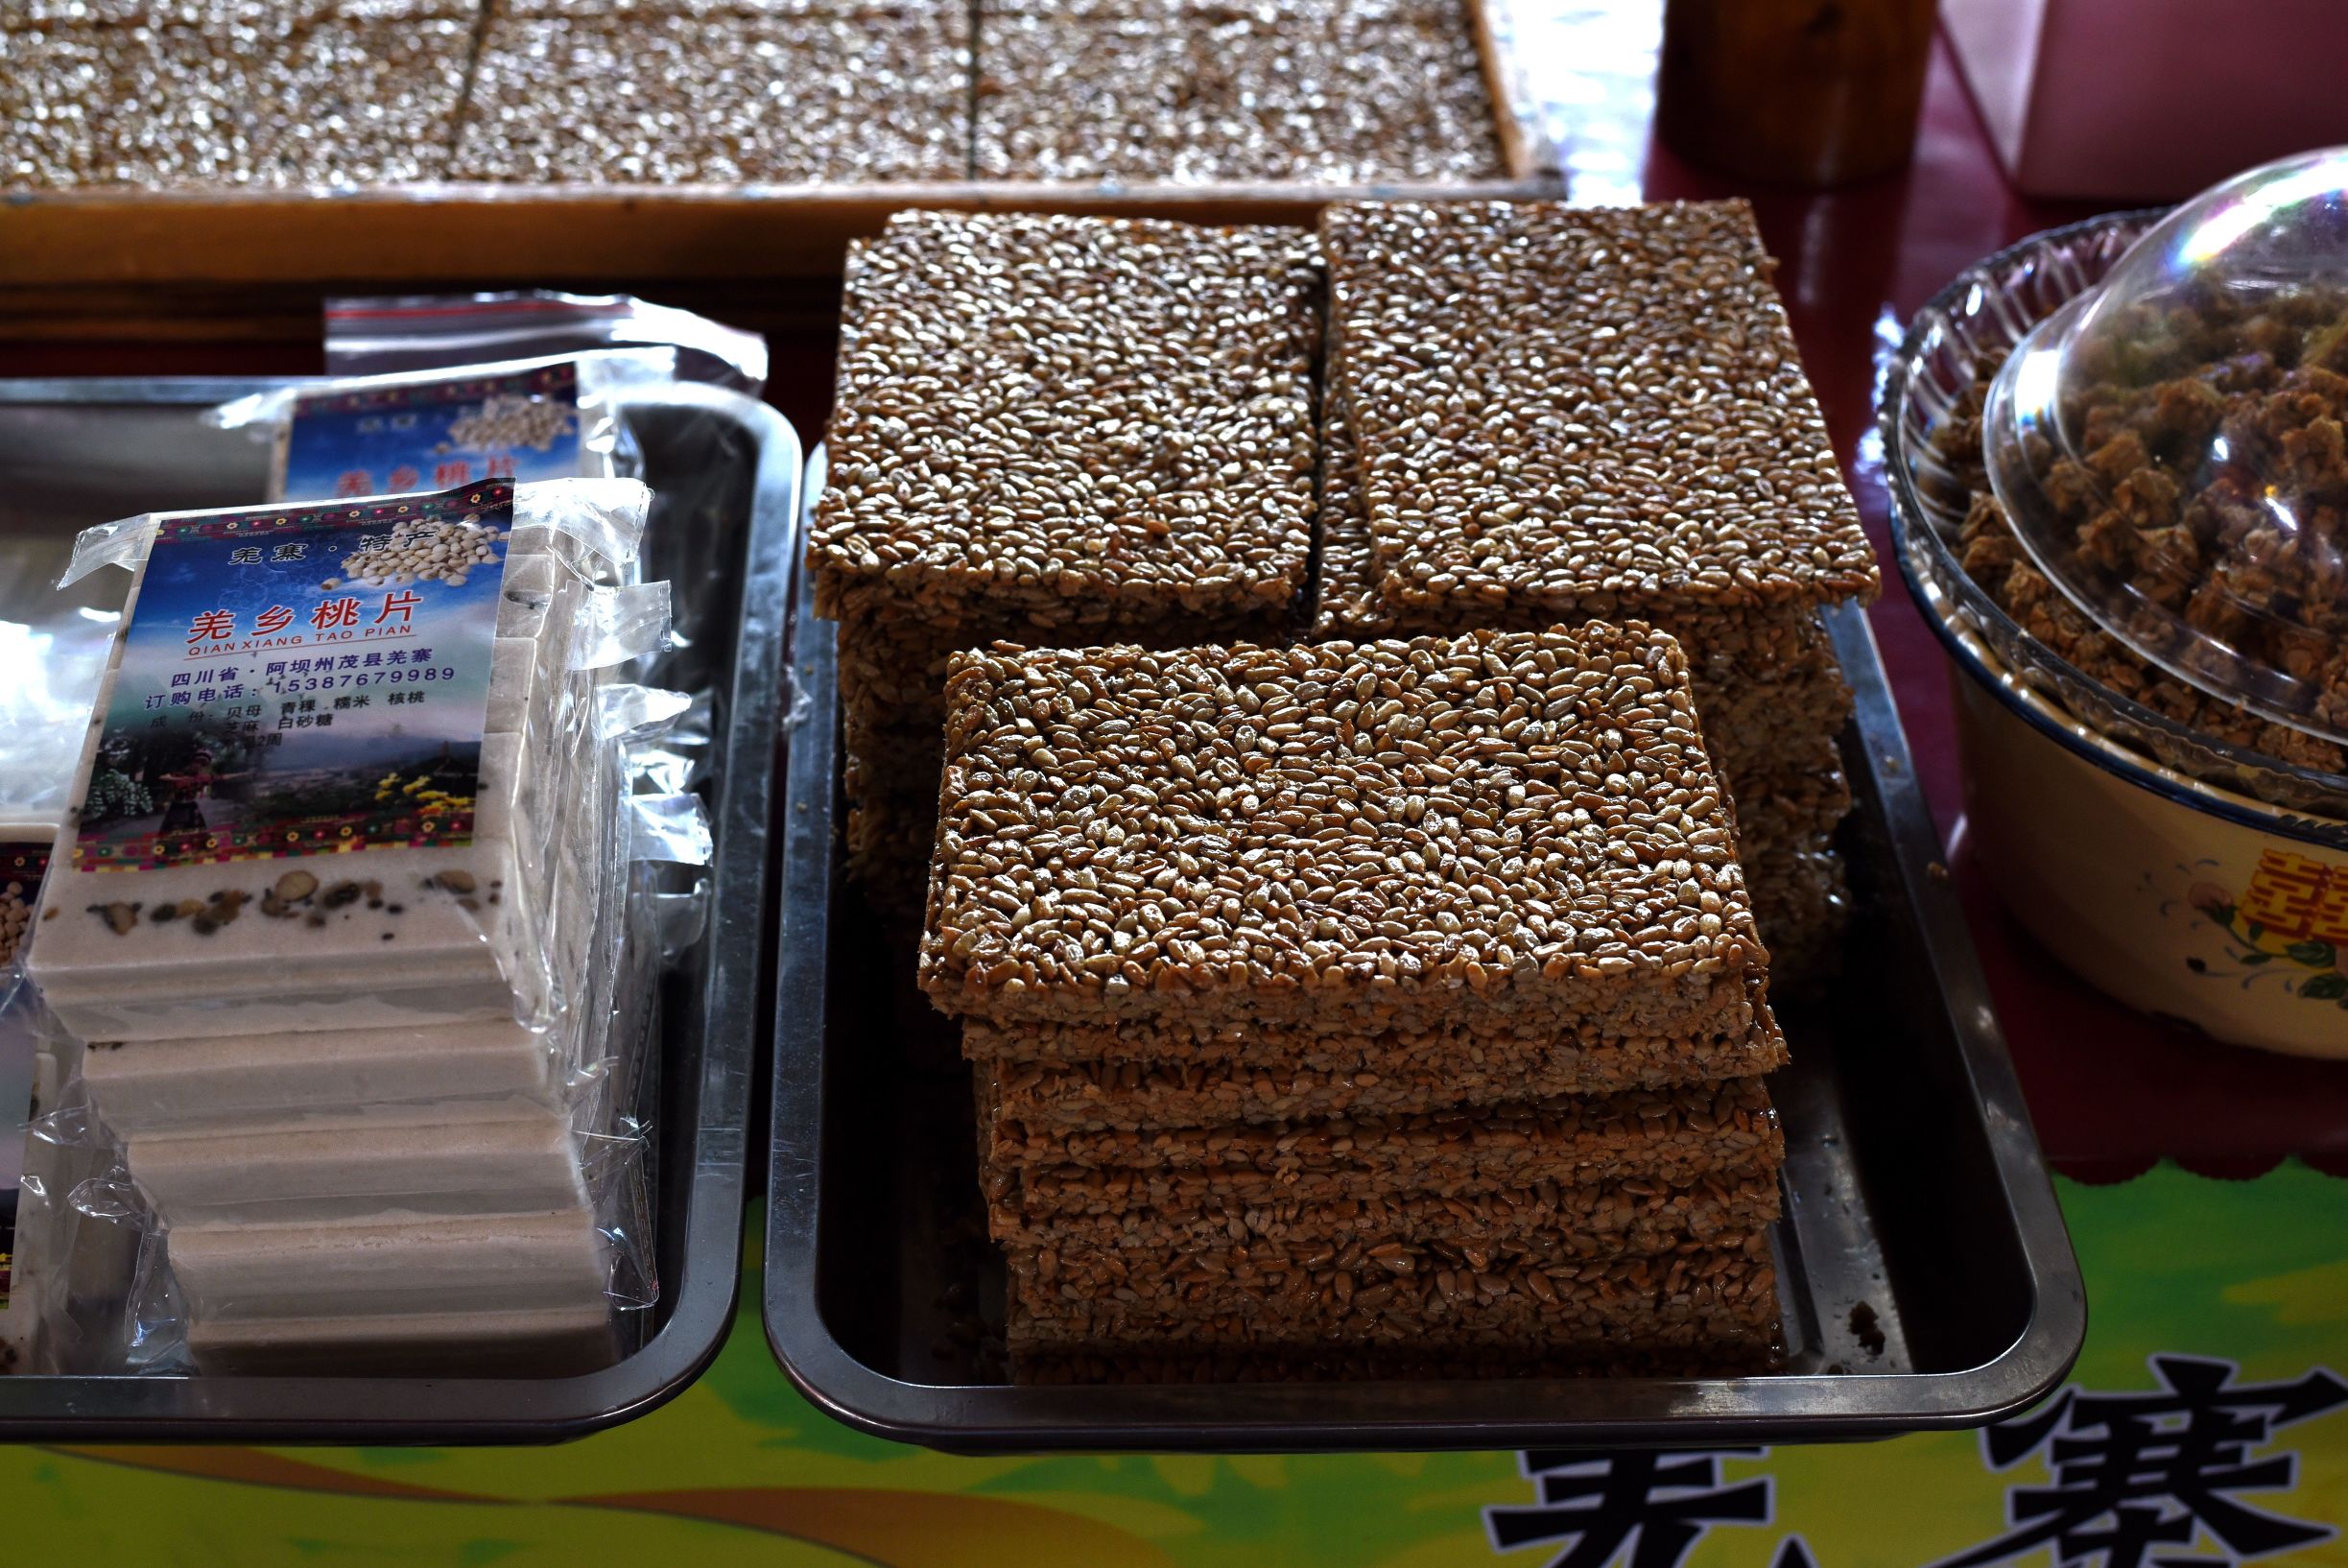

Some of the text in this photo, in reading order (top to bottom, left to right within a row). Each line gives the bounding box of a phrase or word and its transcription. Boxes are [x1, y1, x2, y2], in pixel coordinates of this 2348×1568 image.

[186, 590, 422, 644] 羌乡桃片
[315, 630, 354, 642] TAO
[365, 625, 413, 637] PIAN
[226, 704, 262, 720] 贝母
[333, 694, 370, 710] 糯米
[387, 690, 425, 705] 核桃
[277, 713, 334, 730] 白砂糖
